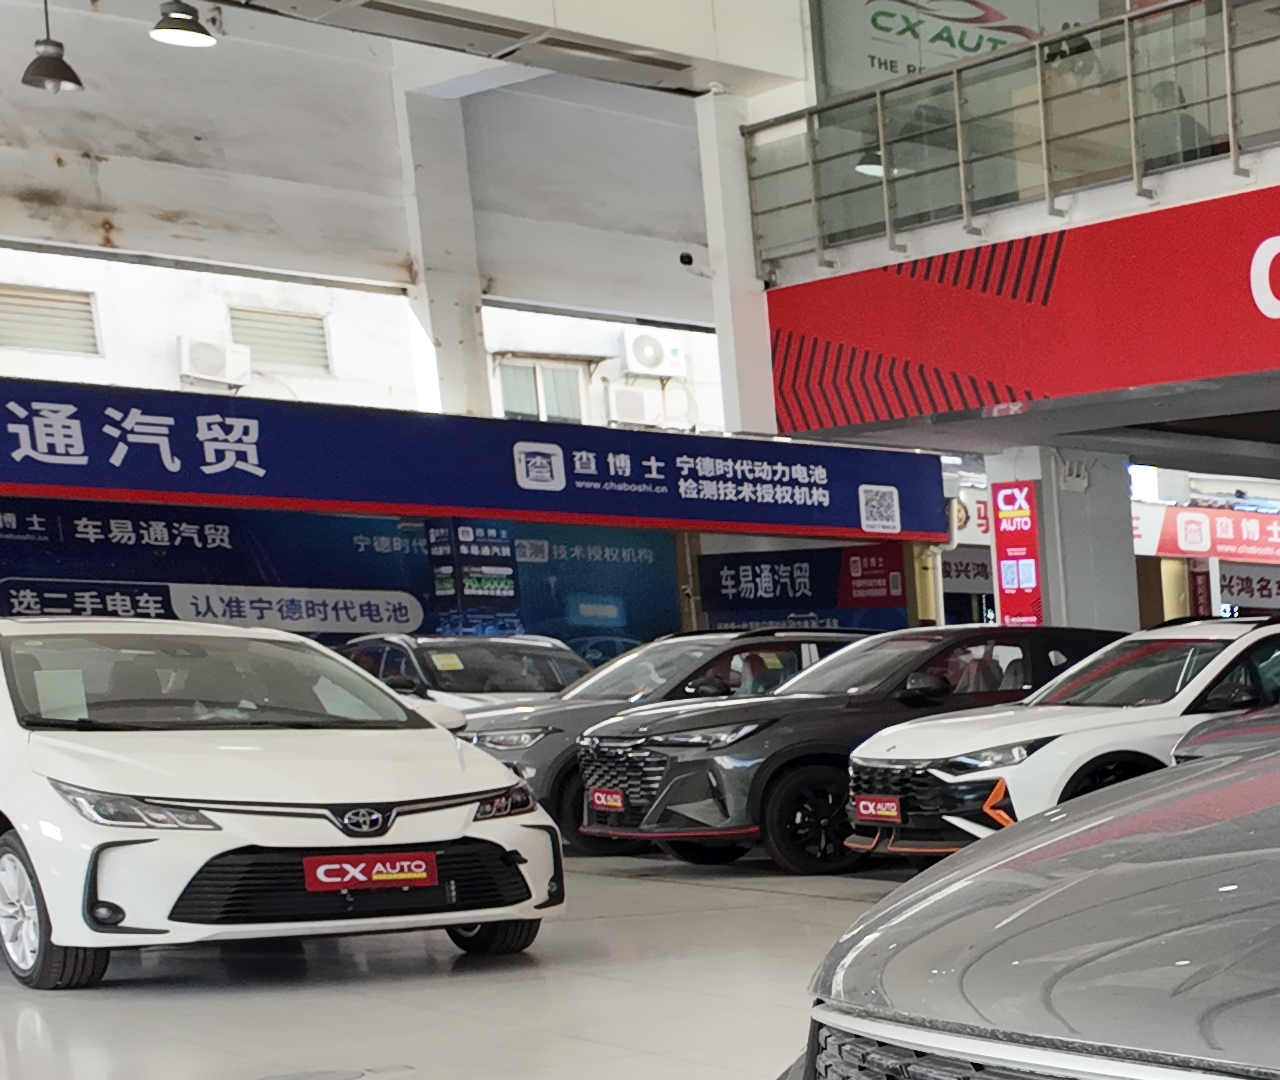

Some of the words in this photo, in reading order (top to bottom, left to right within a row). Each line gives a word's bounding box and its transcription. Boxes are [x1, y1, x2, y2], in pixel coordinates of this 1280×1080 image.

[870, 10, 926, 39] CX
[928, 25, 1008, 53] AUT
[867, 54, 899, 74] THE
[5, 400, 267, 478] 通汽贸
[572, 451, 665, 480] 查博士
[676, 455, 828, 485] 宁德时代动力电池
[678, 478, 830, 507] 检测技术授权机构
[997, 487, 1031, 511] CX
[74, 517, 233, 549] 车易通汽贸
[1000, 517, 1032, 532] AUTO
[720, 562, 812, 600] 车易通汽贸
[9, 588, 165, 617] 选二手电车
[190, 595, 412, 624] 认准宁德时代电池
[859, 801, 876, 815] CX
[316, 863, 369, 883] CX
[372, 860, 427, 874] AUTO
